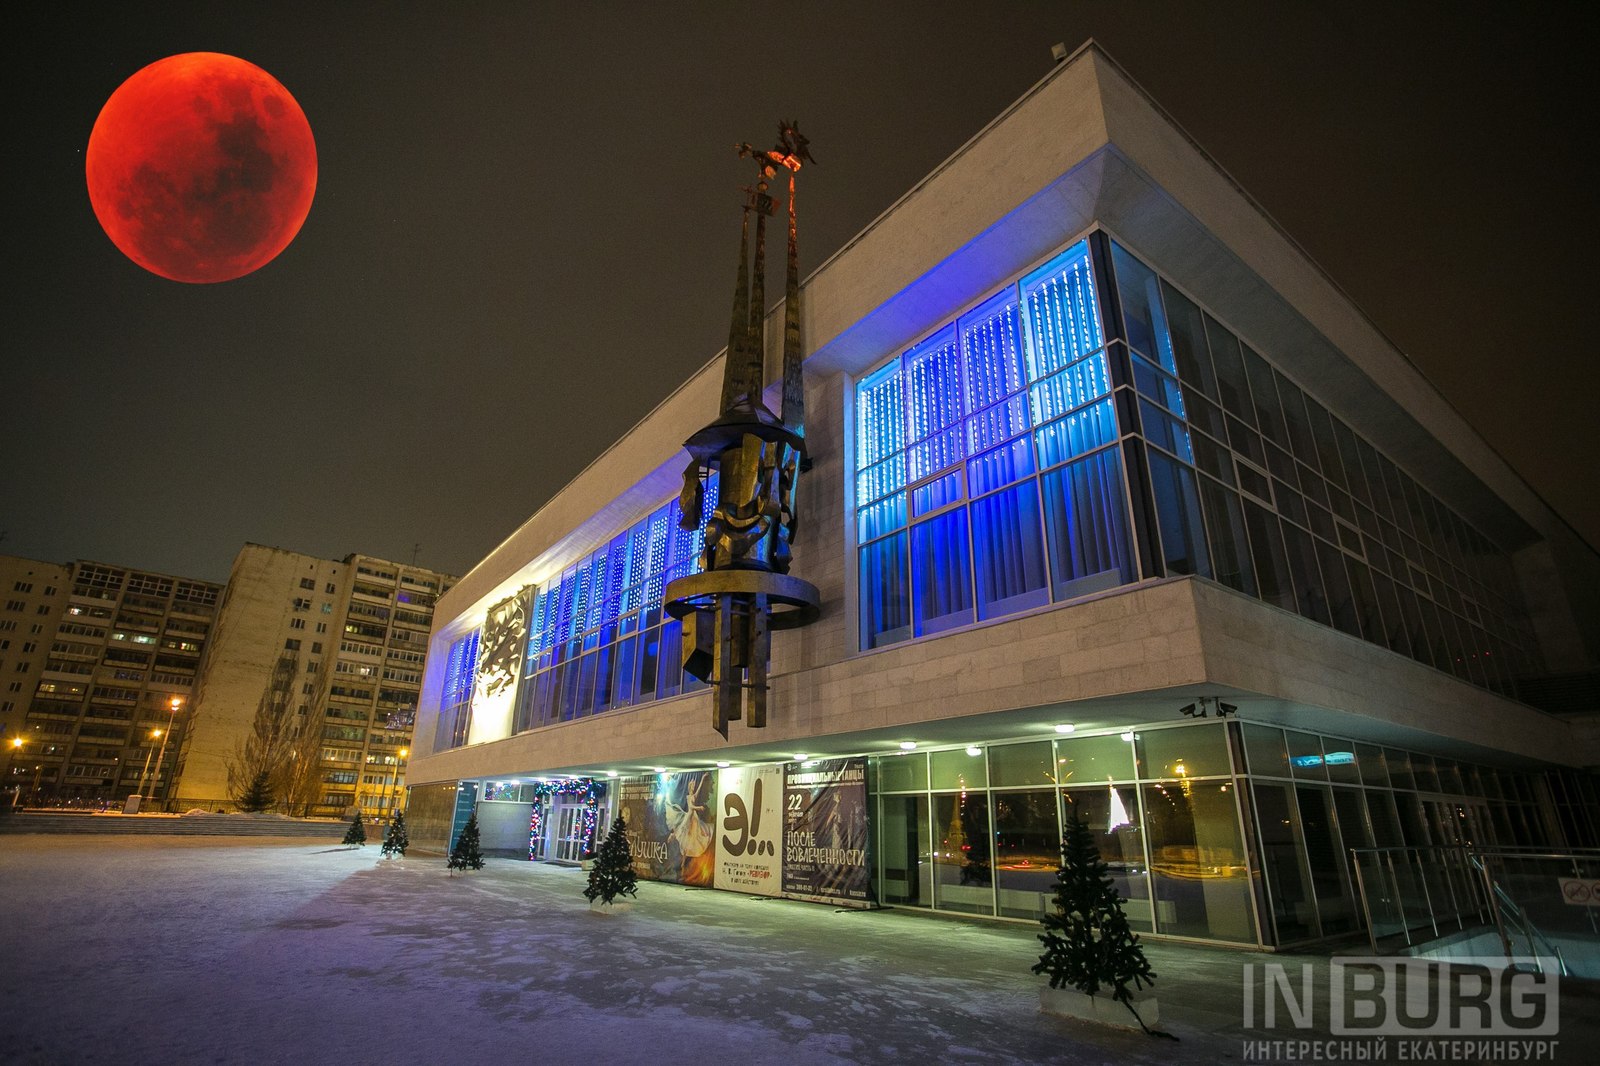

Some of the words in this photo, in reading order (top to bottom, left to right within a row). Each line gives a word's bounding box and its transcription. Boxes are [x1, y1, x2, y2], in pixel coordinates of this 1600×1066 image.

[787, 794, 802, 810] 22
[787, 831, 816, 847] ПОСЛЕ
[786, 847, 865, 867] ВОВЛЕЧЕННОСТИ
